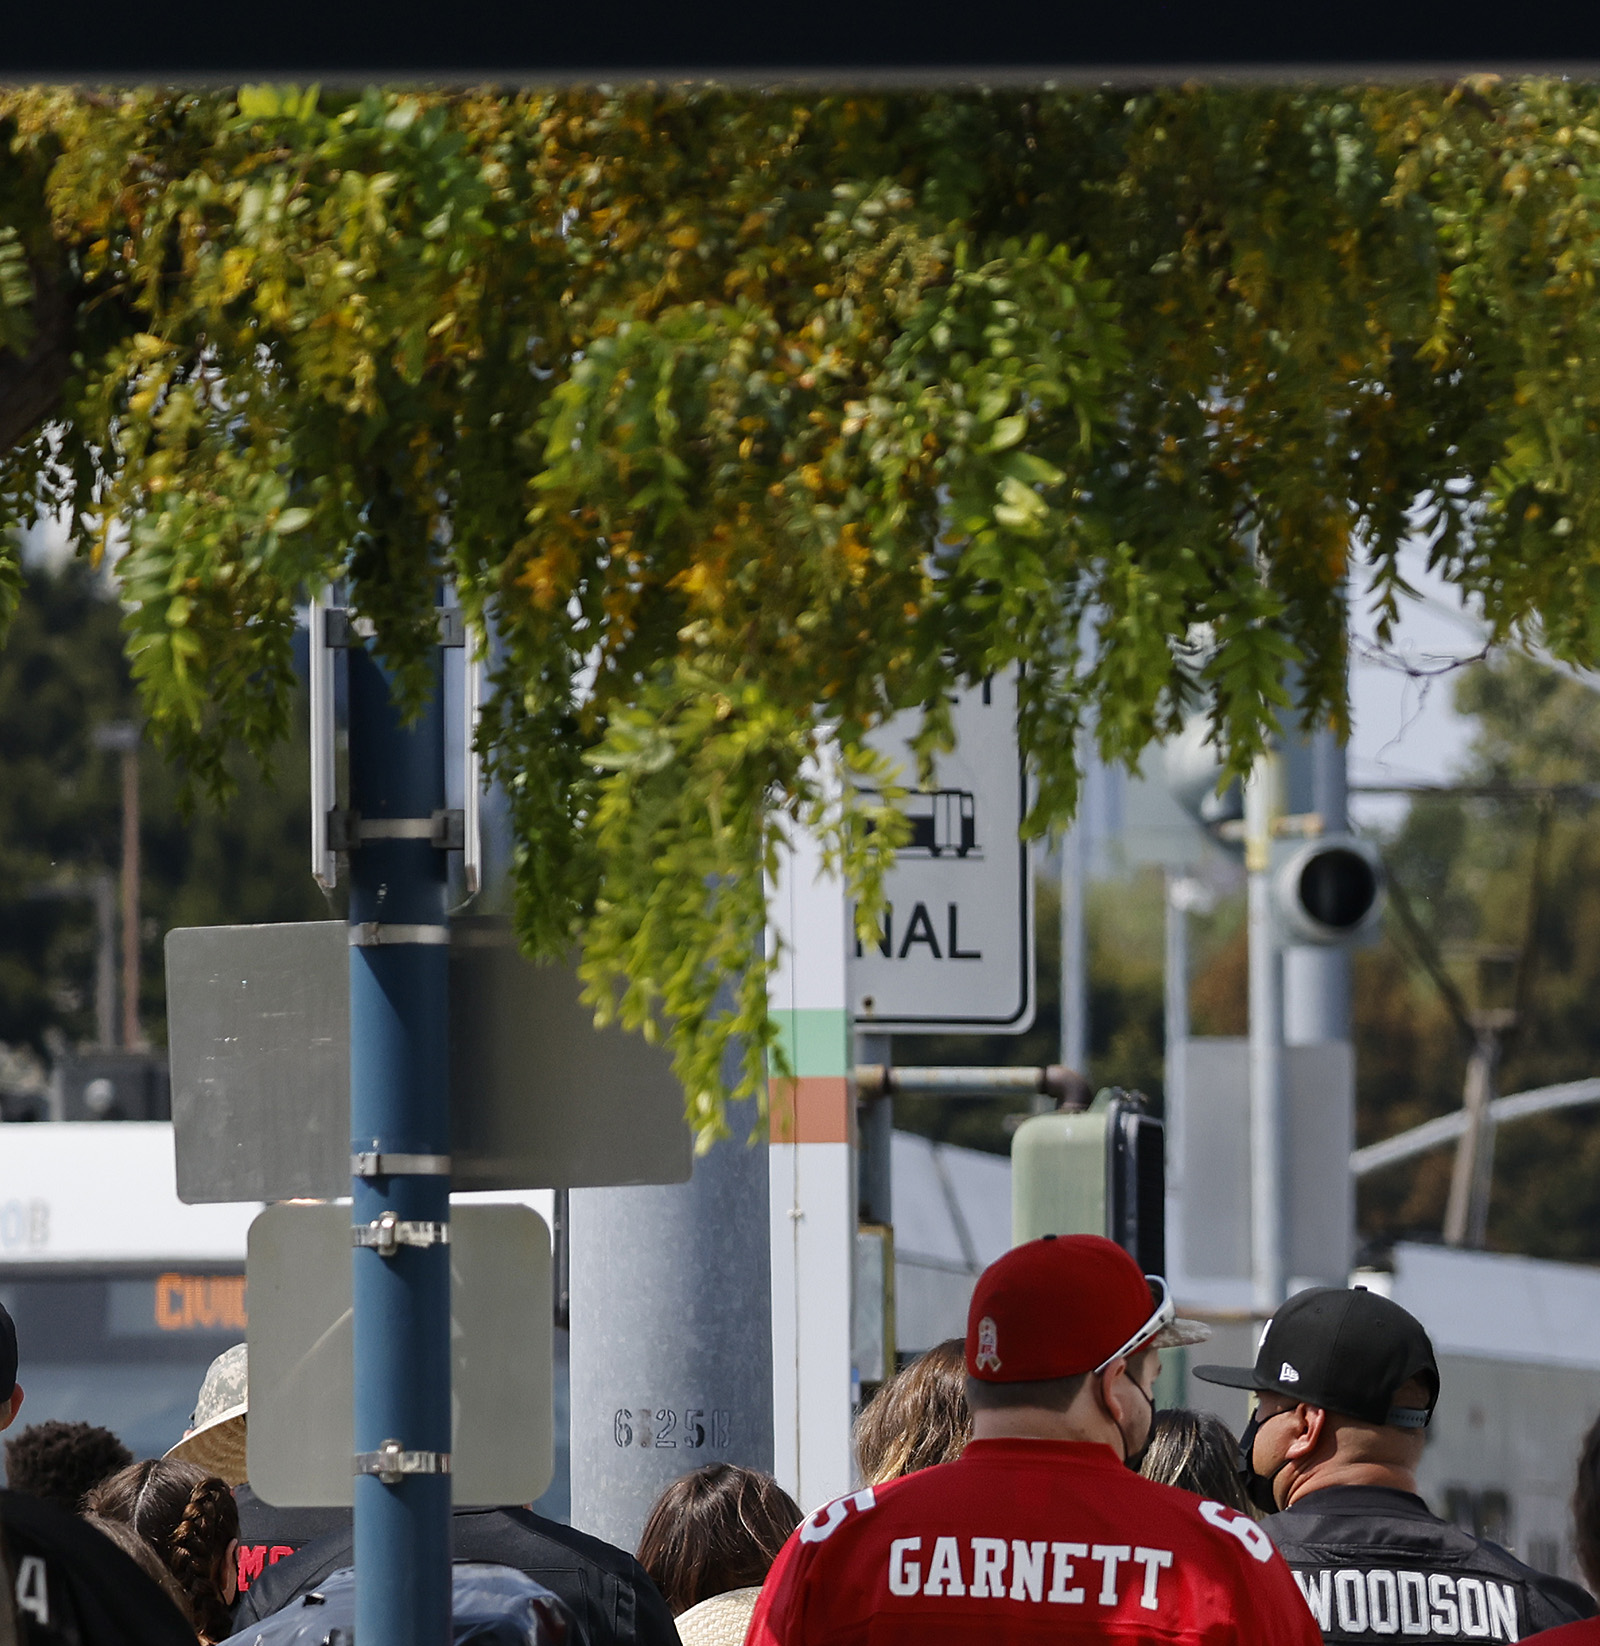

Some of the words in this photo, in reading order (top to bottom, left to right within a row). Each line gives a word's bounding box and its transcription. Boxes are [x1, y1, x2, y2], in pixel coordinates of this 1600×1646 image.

[1199, 1500, 1274, 1563] 6
[888, 1536, 1174, 1611] GARNETT
[1290, 1569, 1520, 1643] WOODSON
